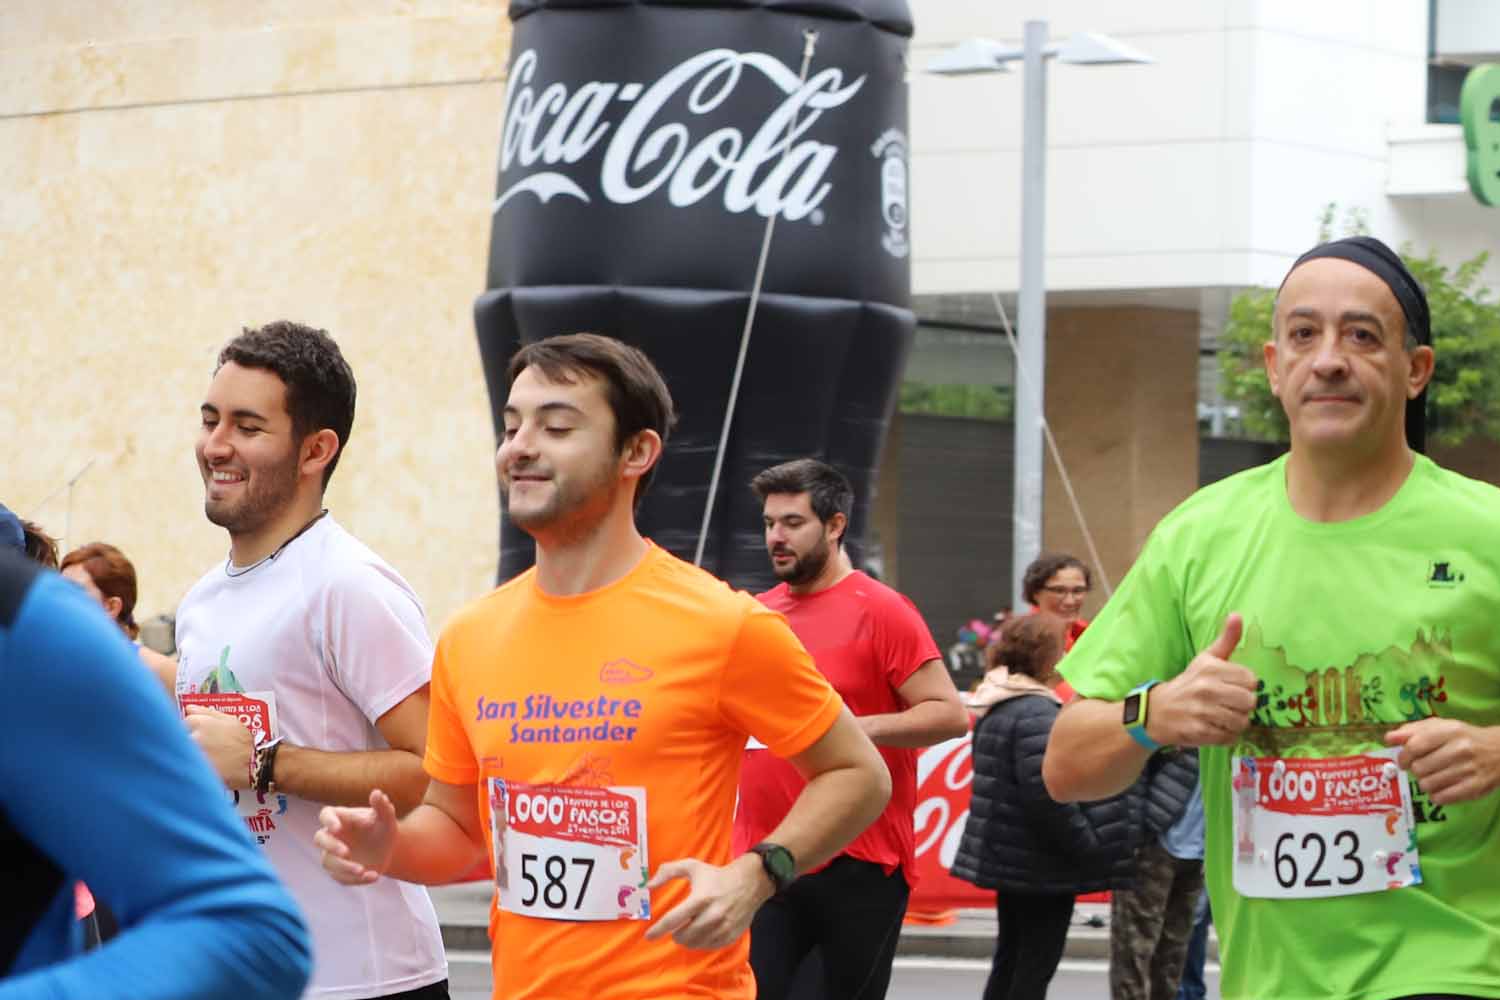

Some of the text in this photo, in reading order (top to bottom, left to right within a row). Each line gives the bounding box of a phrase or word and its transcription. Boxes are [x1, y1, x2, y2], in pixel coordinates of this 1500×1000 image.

[493, 47, 867, 222] Coca-Cola
[476, 694, 643, 721] San Silvestre
[508, 720, 638, 744] Santander
[1323, 775, 1392, 798] PASOS
[505, 792, 564, 825] 1.000
[569, 807, 630, 827] PASOS
[1273, 830, 1364, 889] 623
[520, 853, 596, 910] 587
